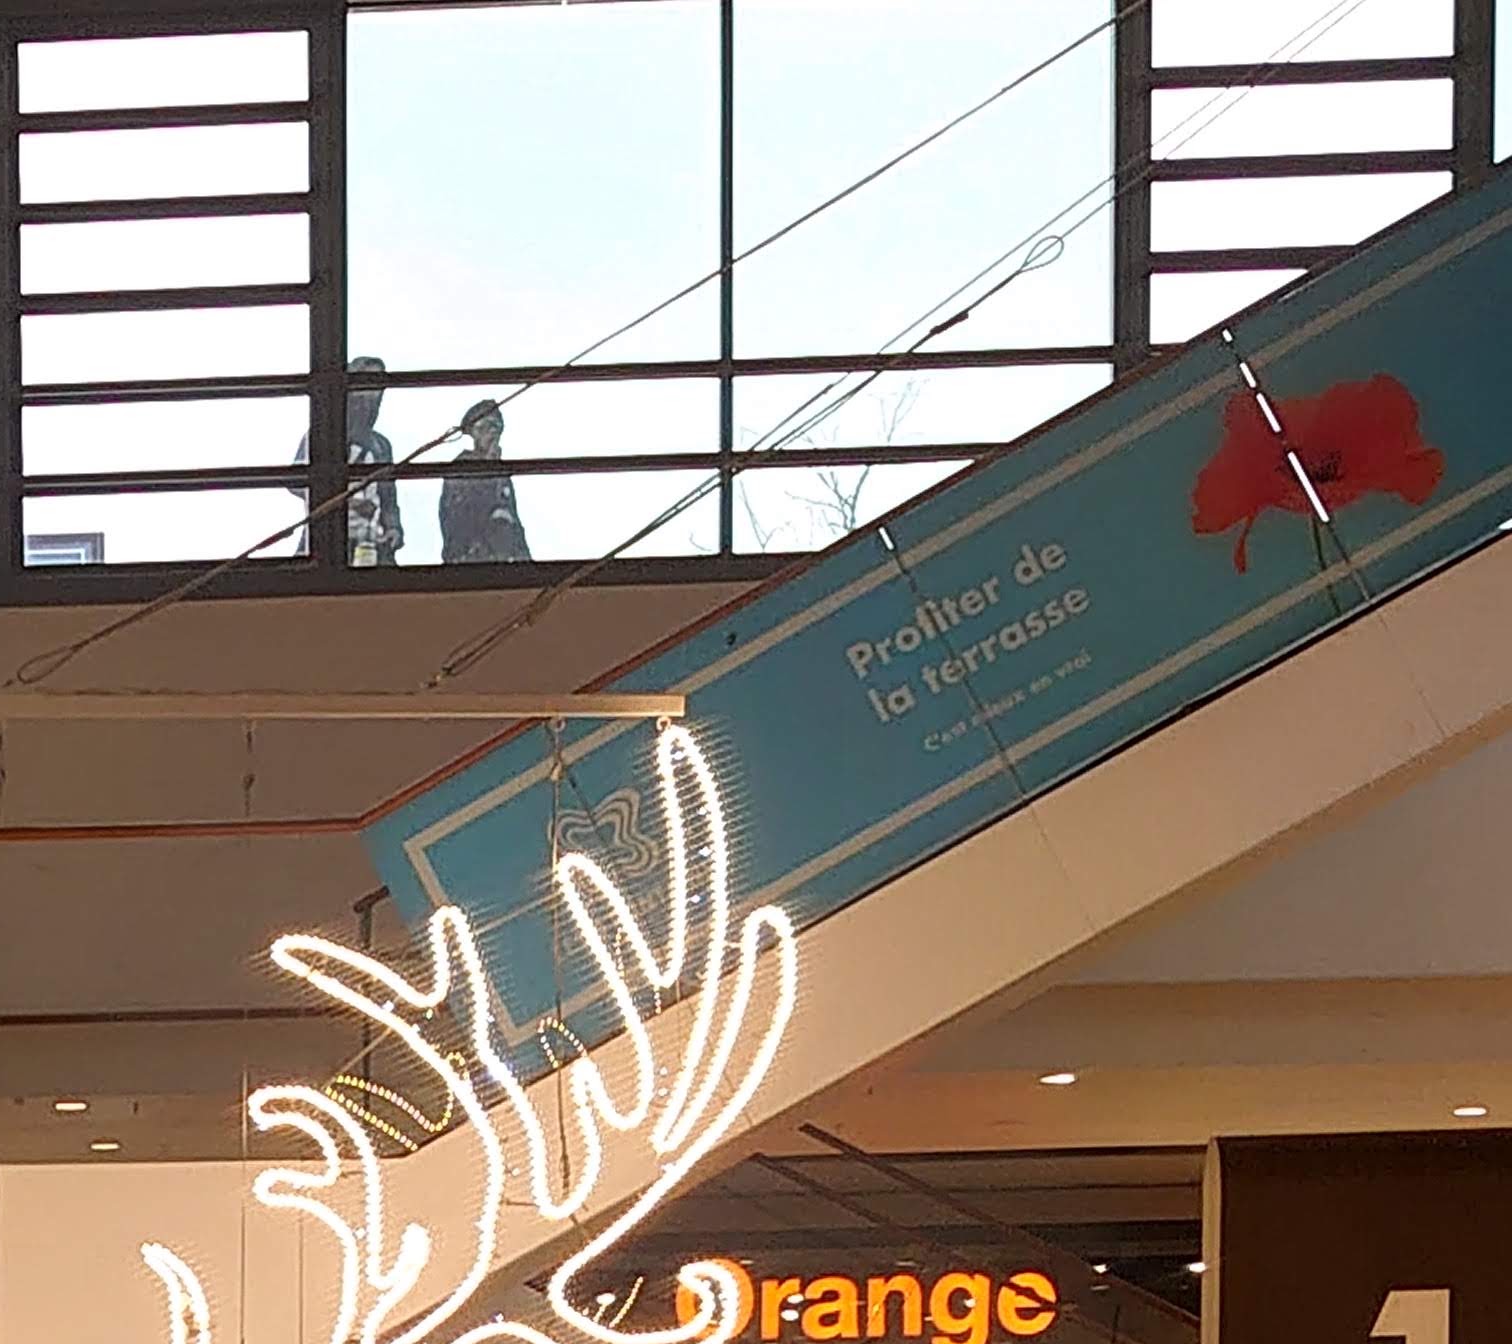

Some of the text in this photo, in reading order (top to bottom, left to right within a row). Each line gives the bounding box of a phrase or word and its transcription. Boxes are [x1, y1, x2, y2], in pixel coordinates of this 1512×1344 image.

[846, 543, 1067, 679] Profiter de
[868, 588, 1089, 722] la terrasse
